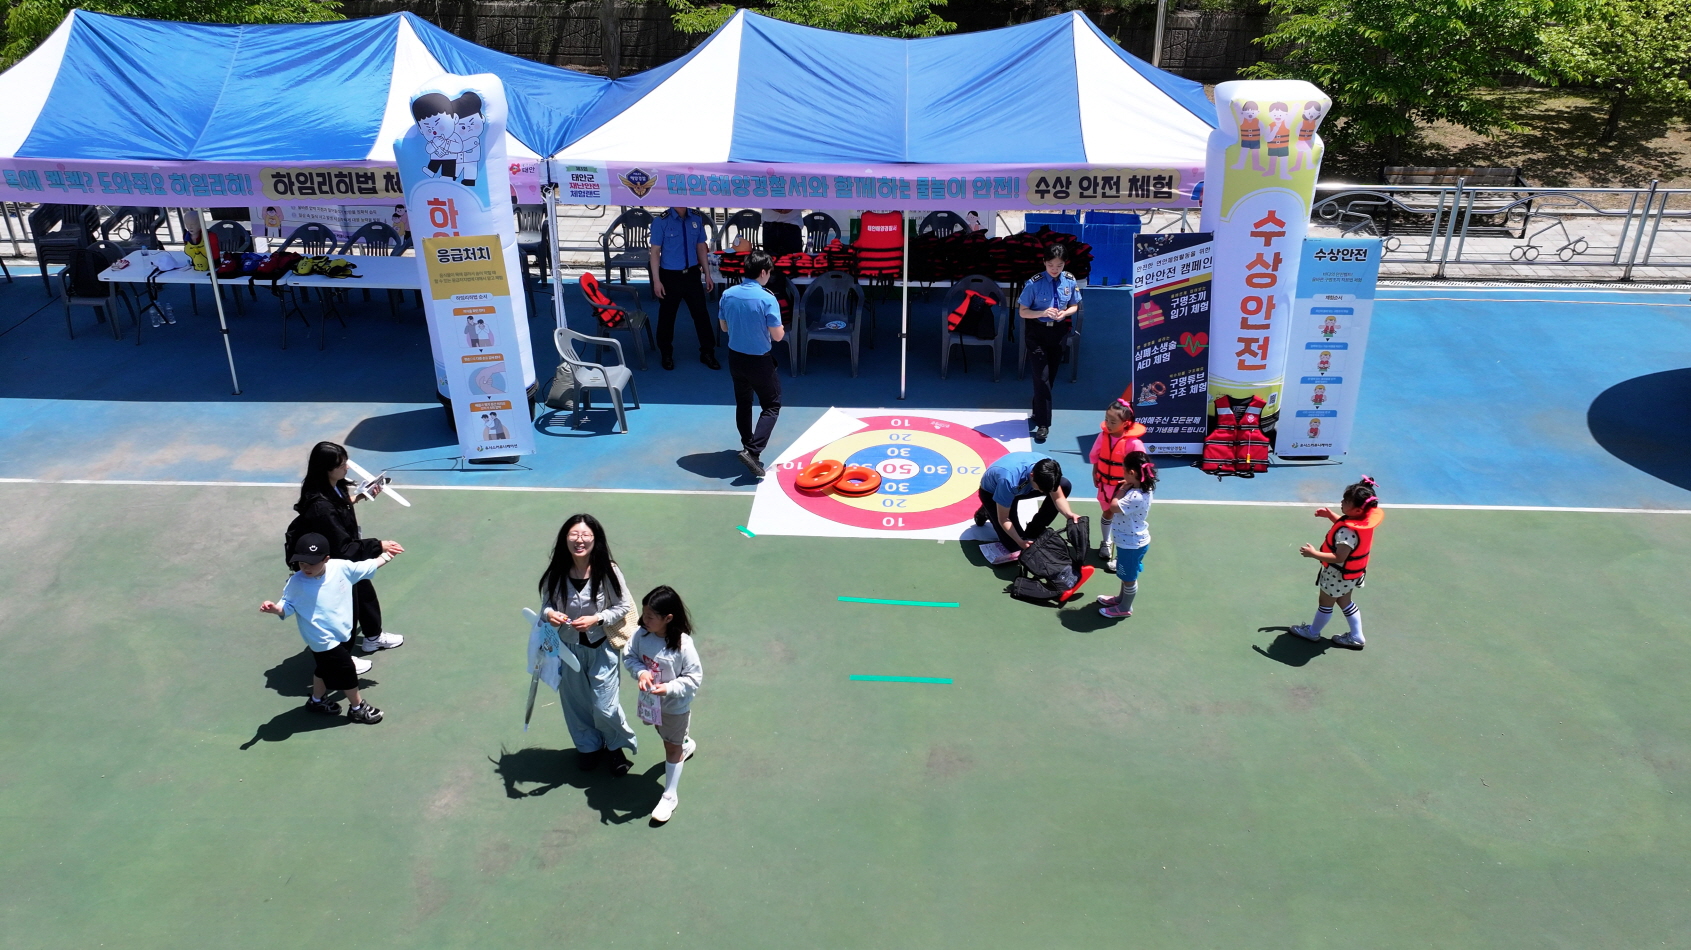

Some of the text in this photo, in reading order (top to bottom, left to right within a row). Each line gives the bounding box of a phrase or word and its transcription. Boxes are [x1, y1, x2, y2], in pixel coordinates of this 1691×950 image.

[522, 166, 536, 174] 태안
[2, 169, 45, 192] 목에
[97, 171, 168, 195] 도와줘요
[168, 173, 254, 196] 하임리히!
[271, 171, 378, 195] 하임리히법
[383, 171, 403, 194] 체
[571, 174, 595, 182] 태안군
[569, 182, 600, 190] 재난안전
[666, 174, 1173, 200] 태안해양경찰서와 함께하는 물놀이 안전! 수상 안전 체험
[570, 190, 600, 198] 체험랜드
[437, 246, 491, 264] 응급처치
[1313, 248, 1368, 262] 수상안전
[1134, 256, 1213, 288] 연안안전 캠페인
[1137, 262, 1154, 273] 안전한
[1234, 209, 1287, 372] 수상안전
[1171, 291, 1207, 308] 구명조끼
[1170, 301, 1209, 320] 입기 체험
[1135, 340, 1177, 361] 심폐소생술
[1136, 352, 1171, 371] AED 체험
[1169, 372, 1205, 389] 구명튜브
[1169, 382, 1207, 399] 구조 체험
[890, 418, 911, 427] 10
[1171, 416, 1202, 424] 모든분께
[1155, 426, 1180, 434] 기념품을
[1180, 426, 1206, 434] 드립니다
[889, 433, 912, 441] 20
[886, 447, 911, 456] 30
[882, 463, 913, 474] 50
[923, 465, 949, 474] 30
[957, 466, 981, 475] 20
[884, 482, 910, 492] 30
[882, 498, 908, 508] 20
[882, 517, 906, 527] 10
